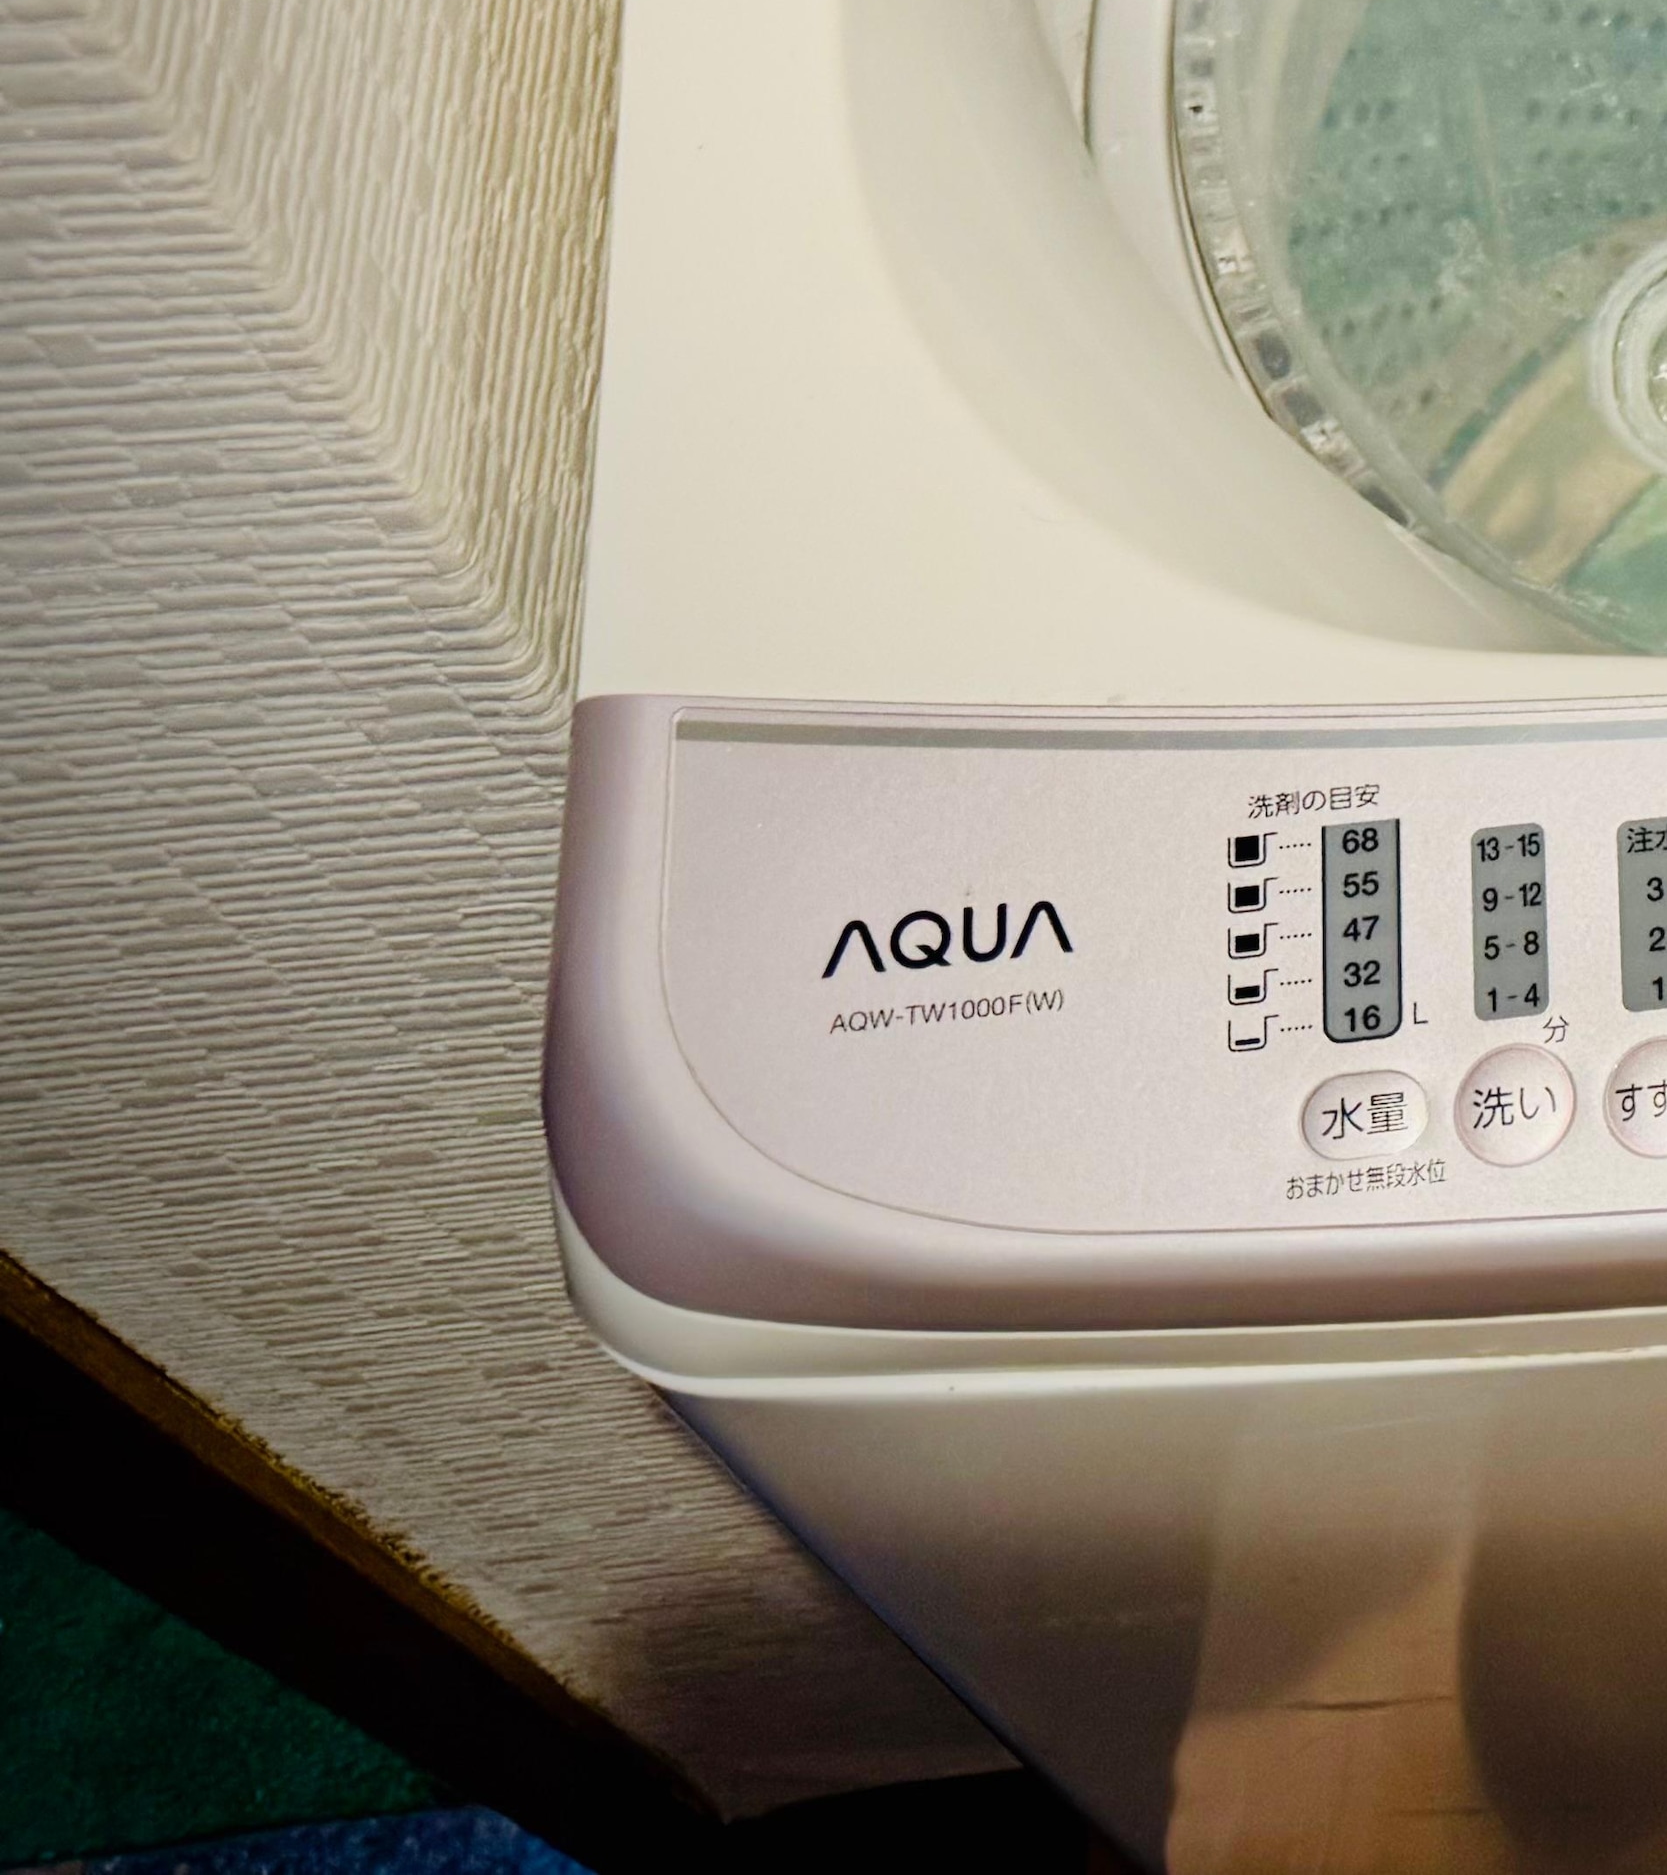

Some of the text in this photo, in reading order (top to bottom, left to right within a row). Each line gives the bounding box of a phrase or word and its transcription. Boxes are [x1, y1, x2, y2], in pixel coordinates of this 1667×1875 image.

[1248, 783, 1380, 819] 洗剤の目安
[1342, 828, 1379, 853] 68
[1476, 831, 1541, 862] 13-15
[1343, 871, 1380, 898] 55
[1483, 882, 1542, 912] 9-12
[1646, 877, 1664, 902] 3
[821, 900, 1074, 979] AQUA
[1343, 916, 1380, 942] 47
[1648, 926, 1666, 952] 2
[1484, 930, 1540, 960] 5-8
[1344, 960, 1381, 987] 32
[1487, 983, 1541, 1013] 1-4
[1652, 976, 1664, 1001] 1
[829, 988, 1065, 1035] AQW-TW1000F(W)
[1345, 1005, 1381, 1032] 16
[1413, 1002, 1428, 1025] L
[1543, 1015, 1569, 1043] 分
[1322, 1091, 1409, 1140] 水量
[1472, 1086, 1557, 1130] 洗い
[1286, 1158, 1447, 1201] おまかせ無段水位
